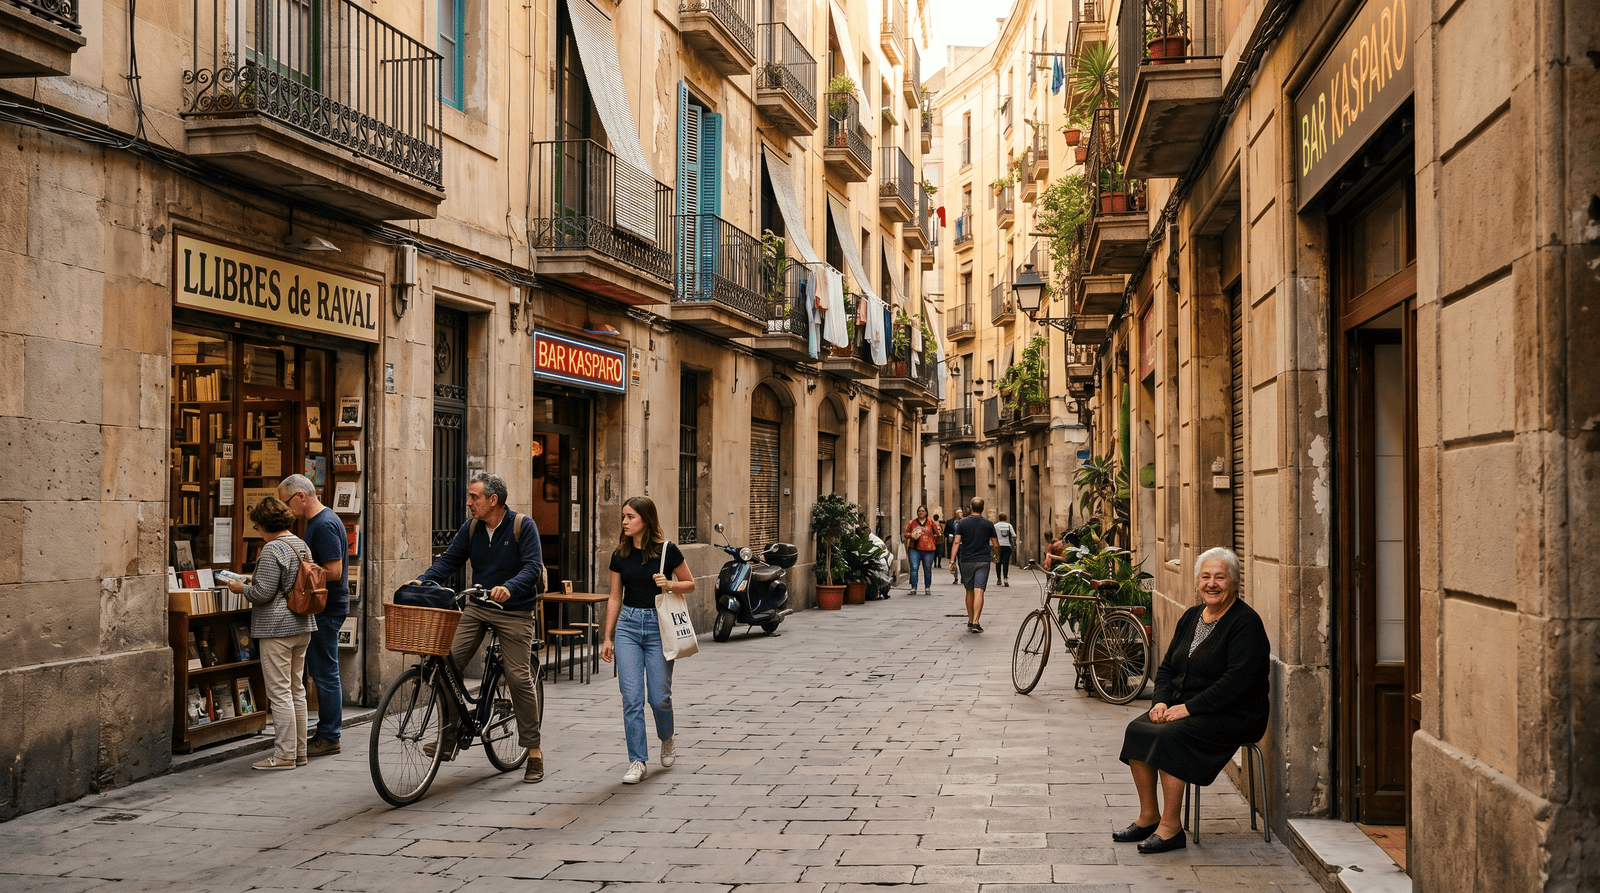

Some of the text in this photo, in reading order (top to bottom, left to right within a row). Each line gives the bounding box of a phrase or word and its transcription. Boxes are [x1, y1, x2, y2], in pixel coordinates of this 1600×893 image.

[1302, 0, 1407, 177] BAR KASPARO
[184, 248, 376, 330] LLIBRES de RAVAL
[538, 340, 566, 372] BAR
[568, 347, 623, 382] KASPARO
